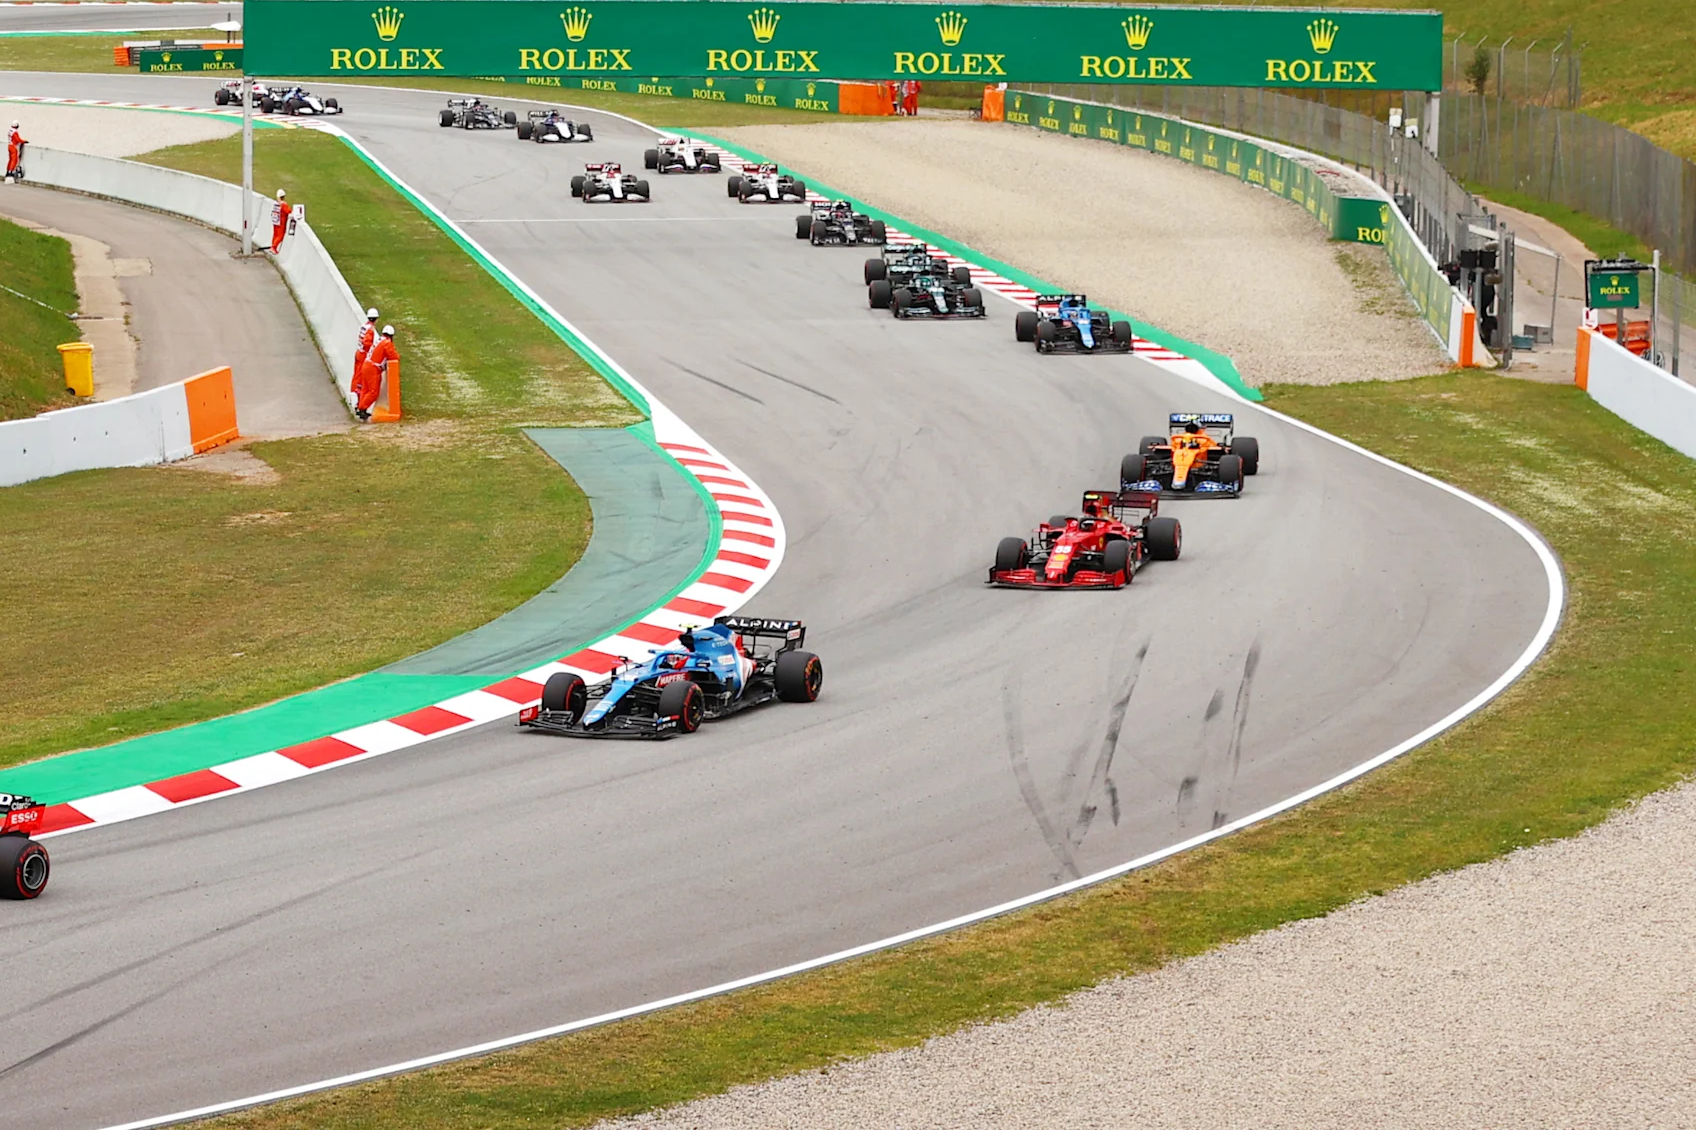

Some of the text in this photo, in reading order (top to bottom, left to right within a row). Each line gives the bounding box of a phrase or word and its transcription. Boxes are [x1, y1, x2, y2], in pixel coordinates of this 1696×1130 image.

[203, 61, 235, 70] ROLEX
[330, 48, 445, 70] ROLEX
[518, 48, 633, 71] ROLEX
[706, 50, 820, 72] ROLEX
[894, 52, 1007, 76] ROLEX
[150, 63, 183, 72] ROLEX
[1080, 55, 1193, 80] ROLEX
[1265, 59, 1378, 83] ROLEX
[581, 80, 617, 92] ROLEX
[638, 83, 673, 96] ROLEX
[692, 88, 726, 102] ROLEX
[744, 93, 777, 106] ROLEX
[794, 98, 829, 112] ROLEX
[1600, 286, 1630, 295] ROLEX
[1054, 545, 1072, 554] 55
[11, 810, 38, 824] ESSO
